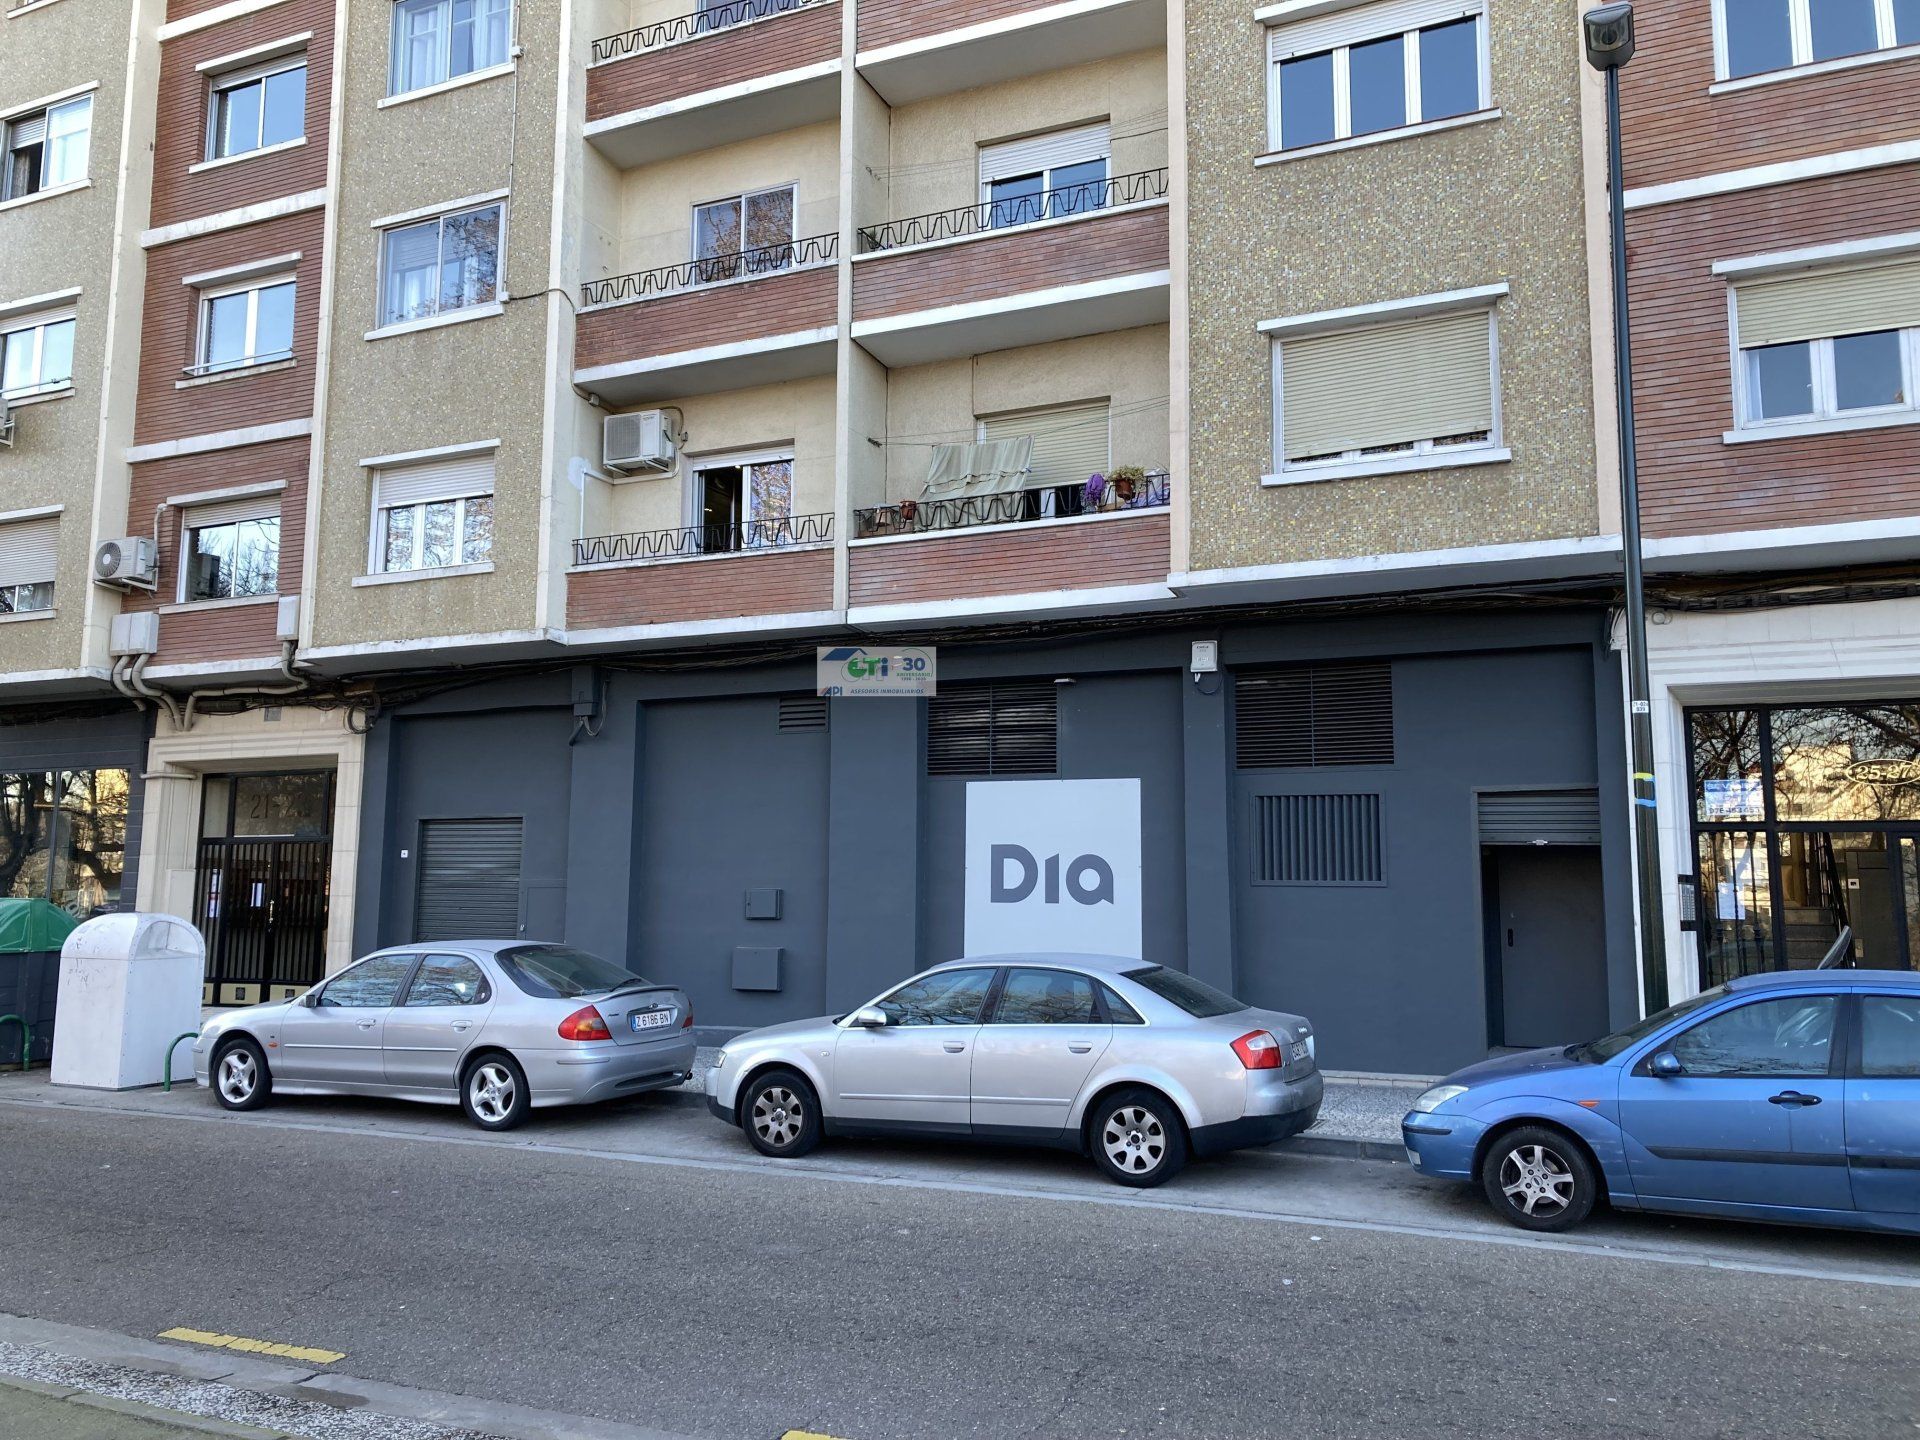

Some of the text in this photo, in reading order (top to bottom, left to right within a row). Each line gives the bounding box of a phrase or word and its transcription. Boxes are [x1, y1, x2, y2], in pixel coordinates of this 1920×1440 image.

[1855, 764, 1911, 779] 25-27
[636, 1016, 641, 1027] Z
[660, 1012, 669, 1024] BN
